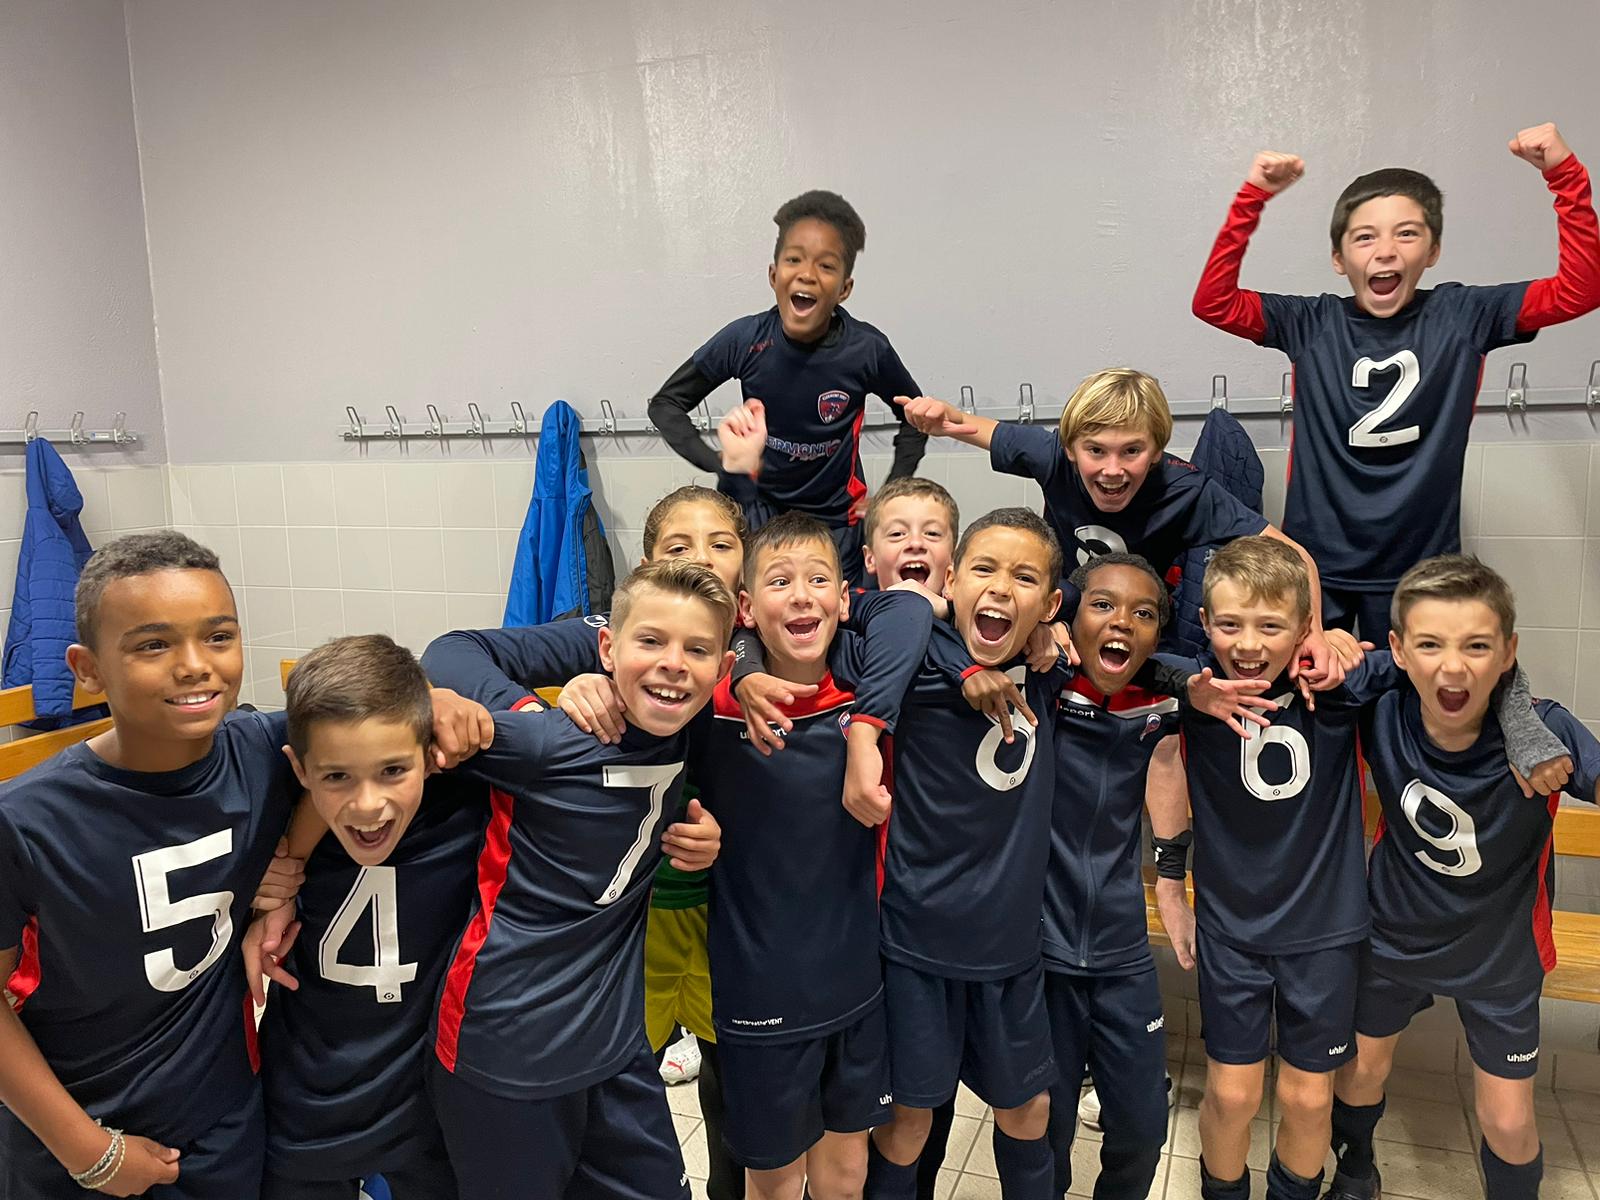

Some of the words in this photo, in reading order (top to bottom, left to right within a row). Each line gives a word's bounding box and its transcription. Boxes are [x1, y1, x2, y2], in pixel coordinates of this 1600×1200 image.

[1348, 349, 1421, 448] 2
[1237, 691, 1311, 801] 6
[594, 761, 684, 905] 7
[1400, 778, 1482, 878] 9
[131, 827, 235, 992] 5
[318, 865, 419, 1003] 4
